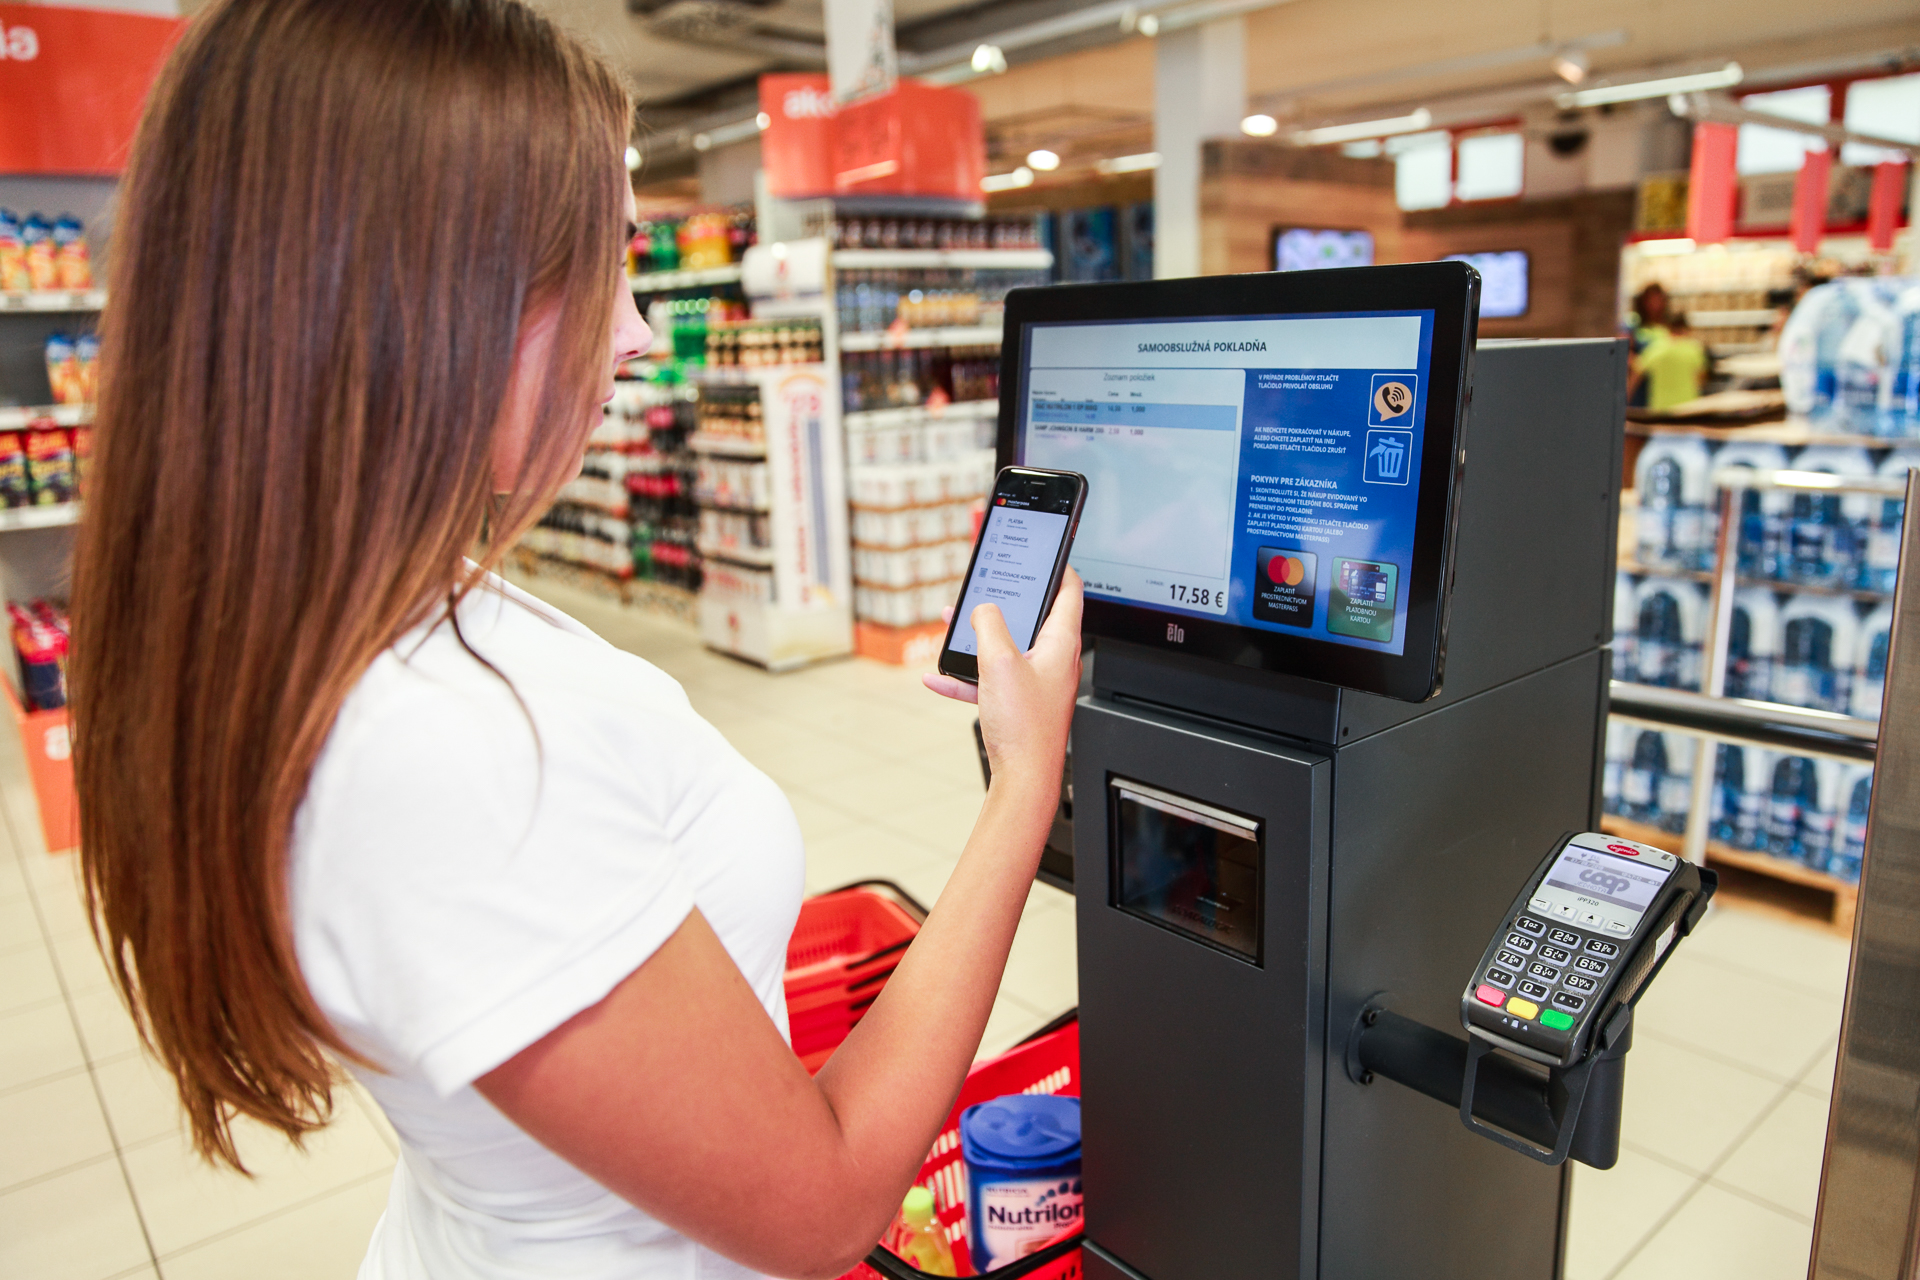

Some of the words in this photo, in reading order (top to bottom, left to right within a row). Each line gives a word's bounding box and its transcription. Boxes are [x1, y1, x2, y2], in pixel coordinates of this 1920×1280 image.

[1137, 340, 1211, 353] SAMOOBSLUŽNÁ
[1213, 339, 1267, 352] POKLADŇA
[1103, 373, 1128, 381] Zoznam
[1284, 373, 1316, 381] PROBLÉMOV
[1288, 427, 1322, 435] POKRAČOVAŤ
[1328, 429, 1351, 437] NÁKUPE,
[1290, 436, 1314, 444] ZAPLATIŤ
[1251, 475, 1279, 484] POKYNY
[1280, 477, 1293, 486] PRE
[1295, 477, 1337, 489] ZÁKAZNÍKA
[1255, 487, 1293, 496] SKONTROLUJTE
[1308, 491, 1326, 499] NÁKUP
[1327, 493, 1359, 502] EVIDOVANÝ
[1249, 503, 1276, 511] PRENESENÝ
[1285, 506, 1312, 514] POKLADNE
[1297, 498, 1321, 507] TELEFÓNE
[1334, 502, 1358, 510] SPRÁVNE
[1268, 513, 1286, 521] VŠETKO
[1292, 516, 1318, 525] PORIADKU
[1319, 518, 1340, 527] STLAČTE
[1342, 521, 1368, 530] TLAČIDLO
[1271, 522, 1300, 531] PLATOBNOU
[1302, 526, 1323, 534] KARTOU
[1324, 528, 1343, 536] (ALEBO
[1003, 535, 1028, 543] TRANSAKCIE
[1247, 528, 1294, 539] PROSTREDNÍCTVOM
[1295, 533, 1330, 543] MASTERPASS)
[992, 570, 1020, 578] DORUČOVACIE
[1106, 582, 1121, 592] kartu
[1274, 586, 1295, 594] ZAPLATIŤ
[1170, 584, 1210, 605] 17,58
[1215, 592, 1224, 608] €
[1261, 593, 1307, 605] PROSTREDNÍCTVOM
[1268, 602, 1298, 612] MASTERPASS
[1350, 598, 1374, 607] ZAPLATIŤ
[1346, 606, 1376, 616] PLATOBNOU
[1350, 615, 1371, 624] KARTOU
[1610, 845, 1637, 855] ingenico
[1574, 880, 1608, 894] JEDNOTA
[1579, 869, 1630, 895] coop
[1577, 897, 1599, 906] iPP320
[1523, 983, 1533, 992] 0
